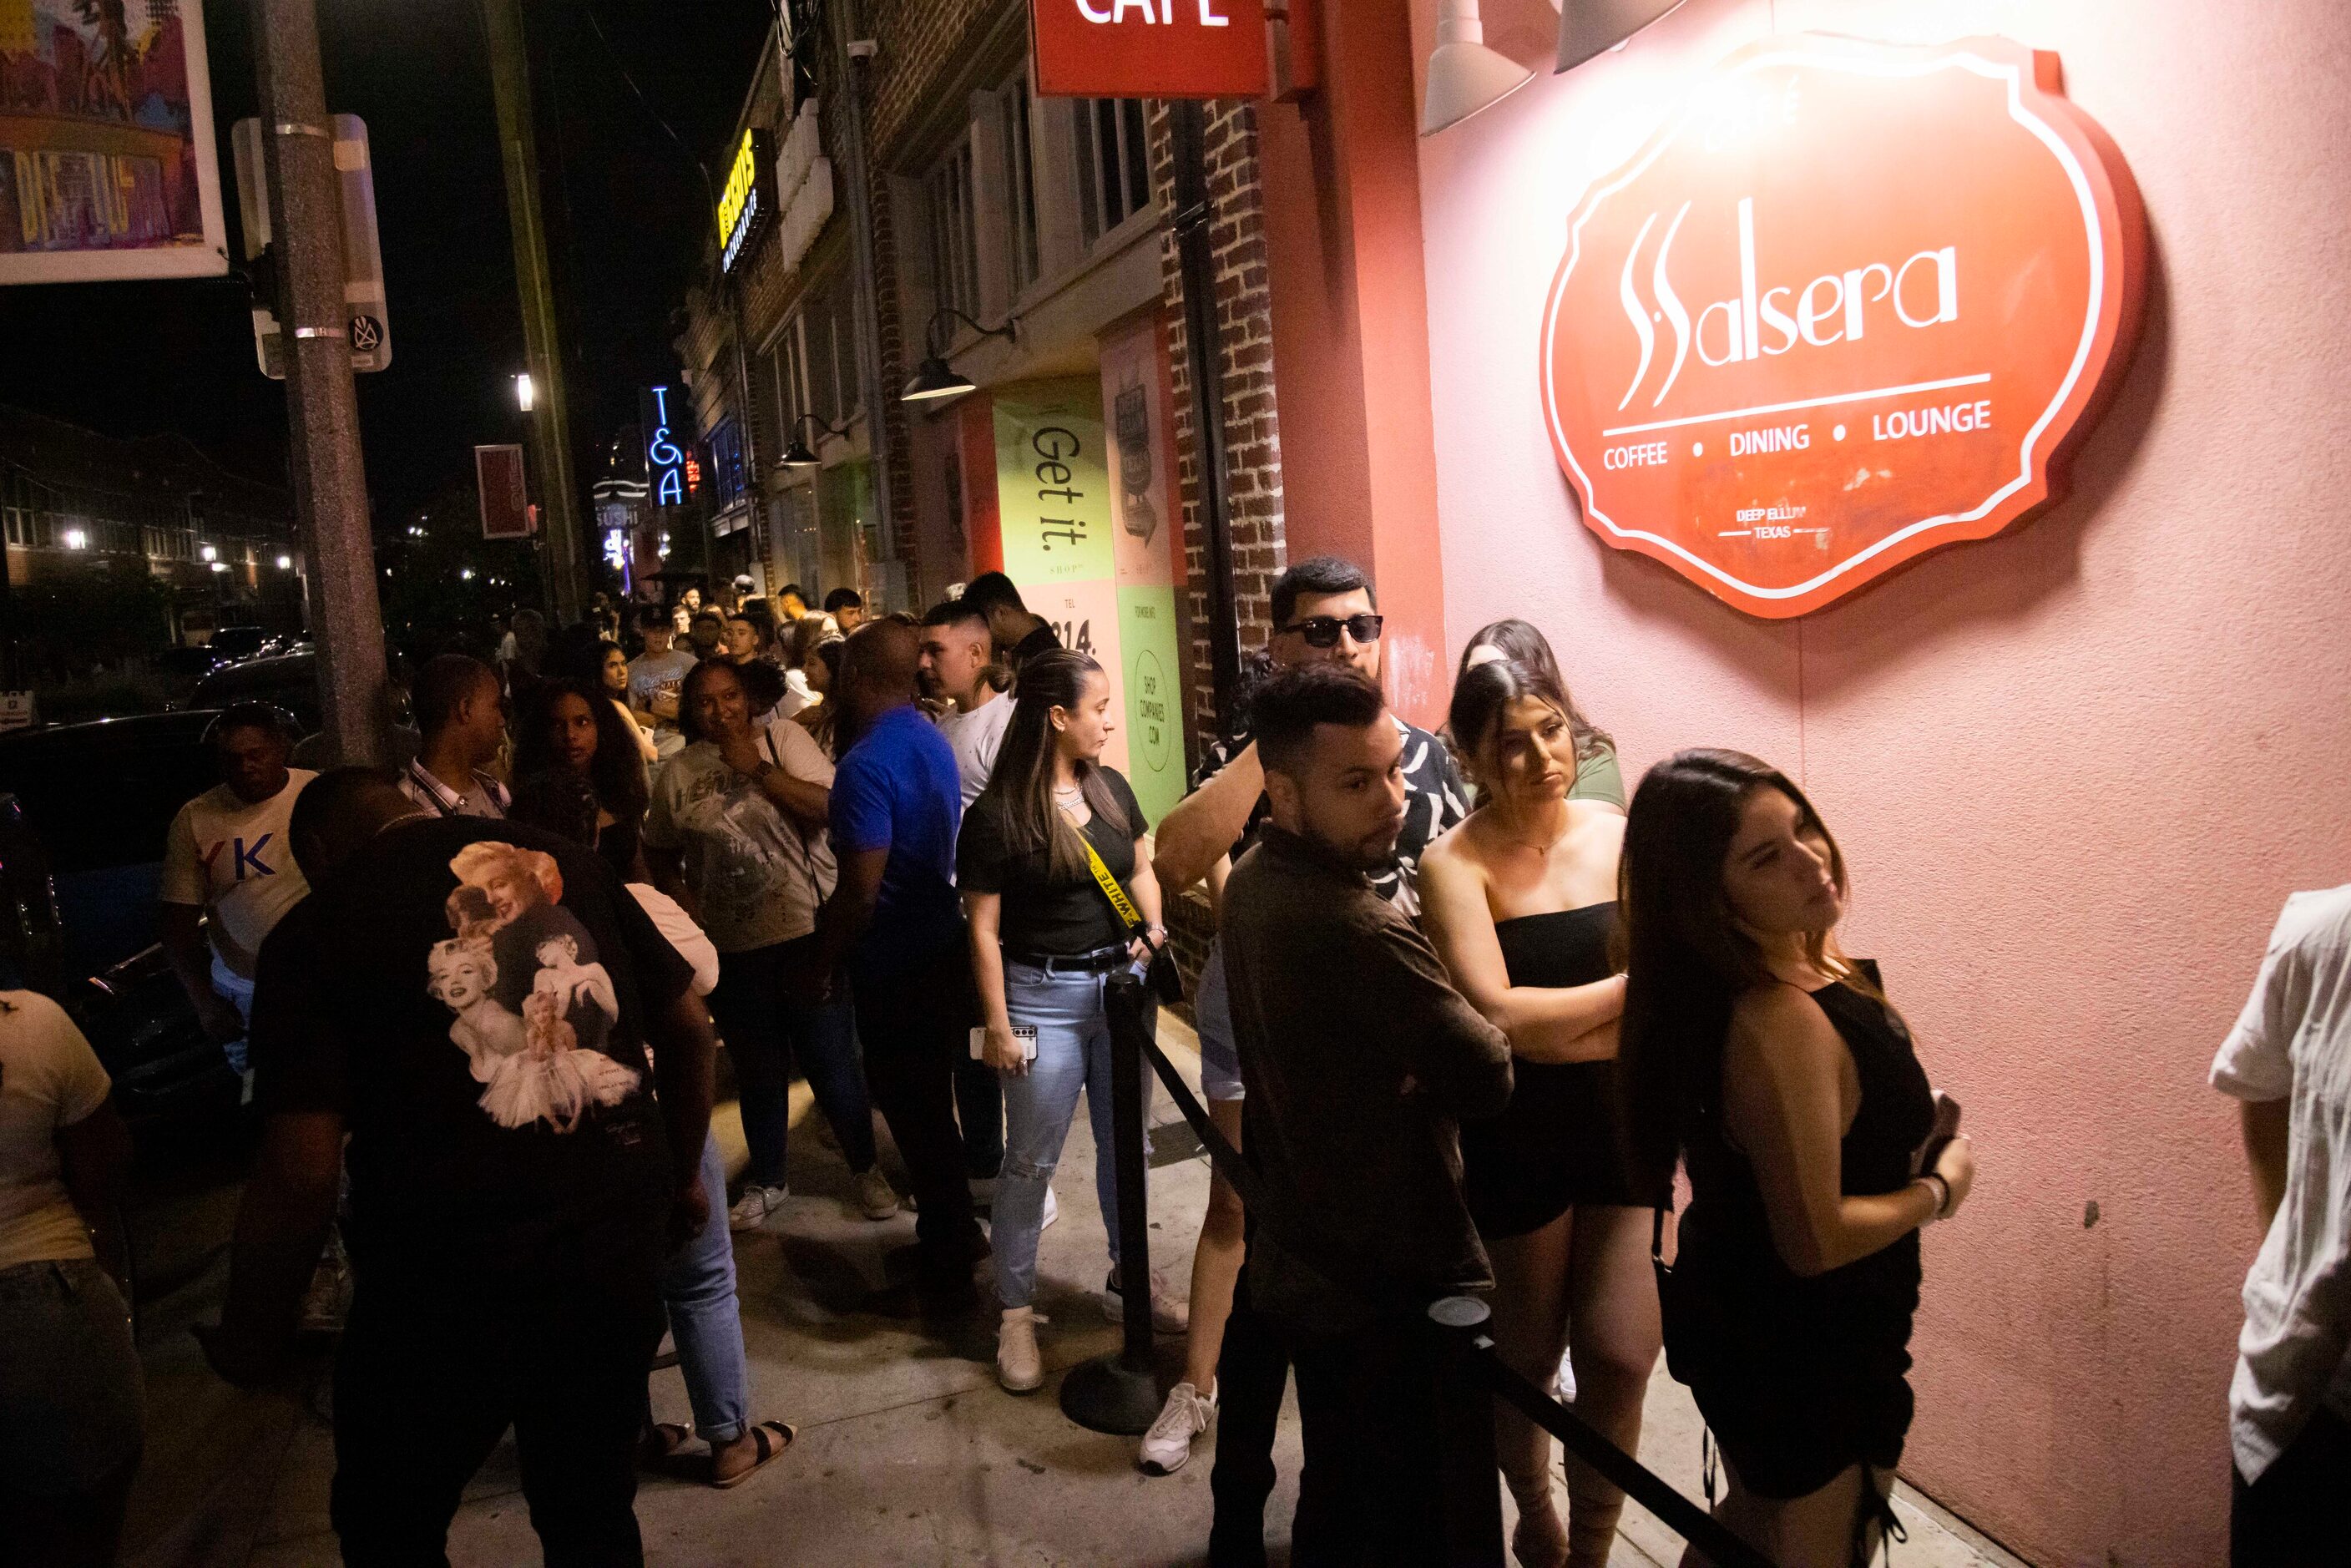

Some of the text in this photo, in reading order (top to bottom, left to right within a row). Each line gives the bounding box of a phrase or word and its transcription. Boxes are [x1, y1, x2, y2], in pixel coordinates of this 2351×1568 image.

[1617, 195, 1959, 412] Salsera
[1603, 400, 1992, 471] COFFEE DINING LOUNGE
[1032, 426, 1088, 552] Get it.
[1736, 508, 1766, 523] DEEP
[1752, 526, 1792, 539] TEXAS
[1064, 599, 1076, 609] TEL
[1144, 675, 1156, 695] SHOP
[1140, 701, 1165, 723] COMPANIES
